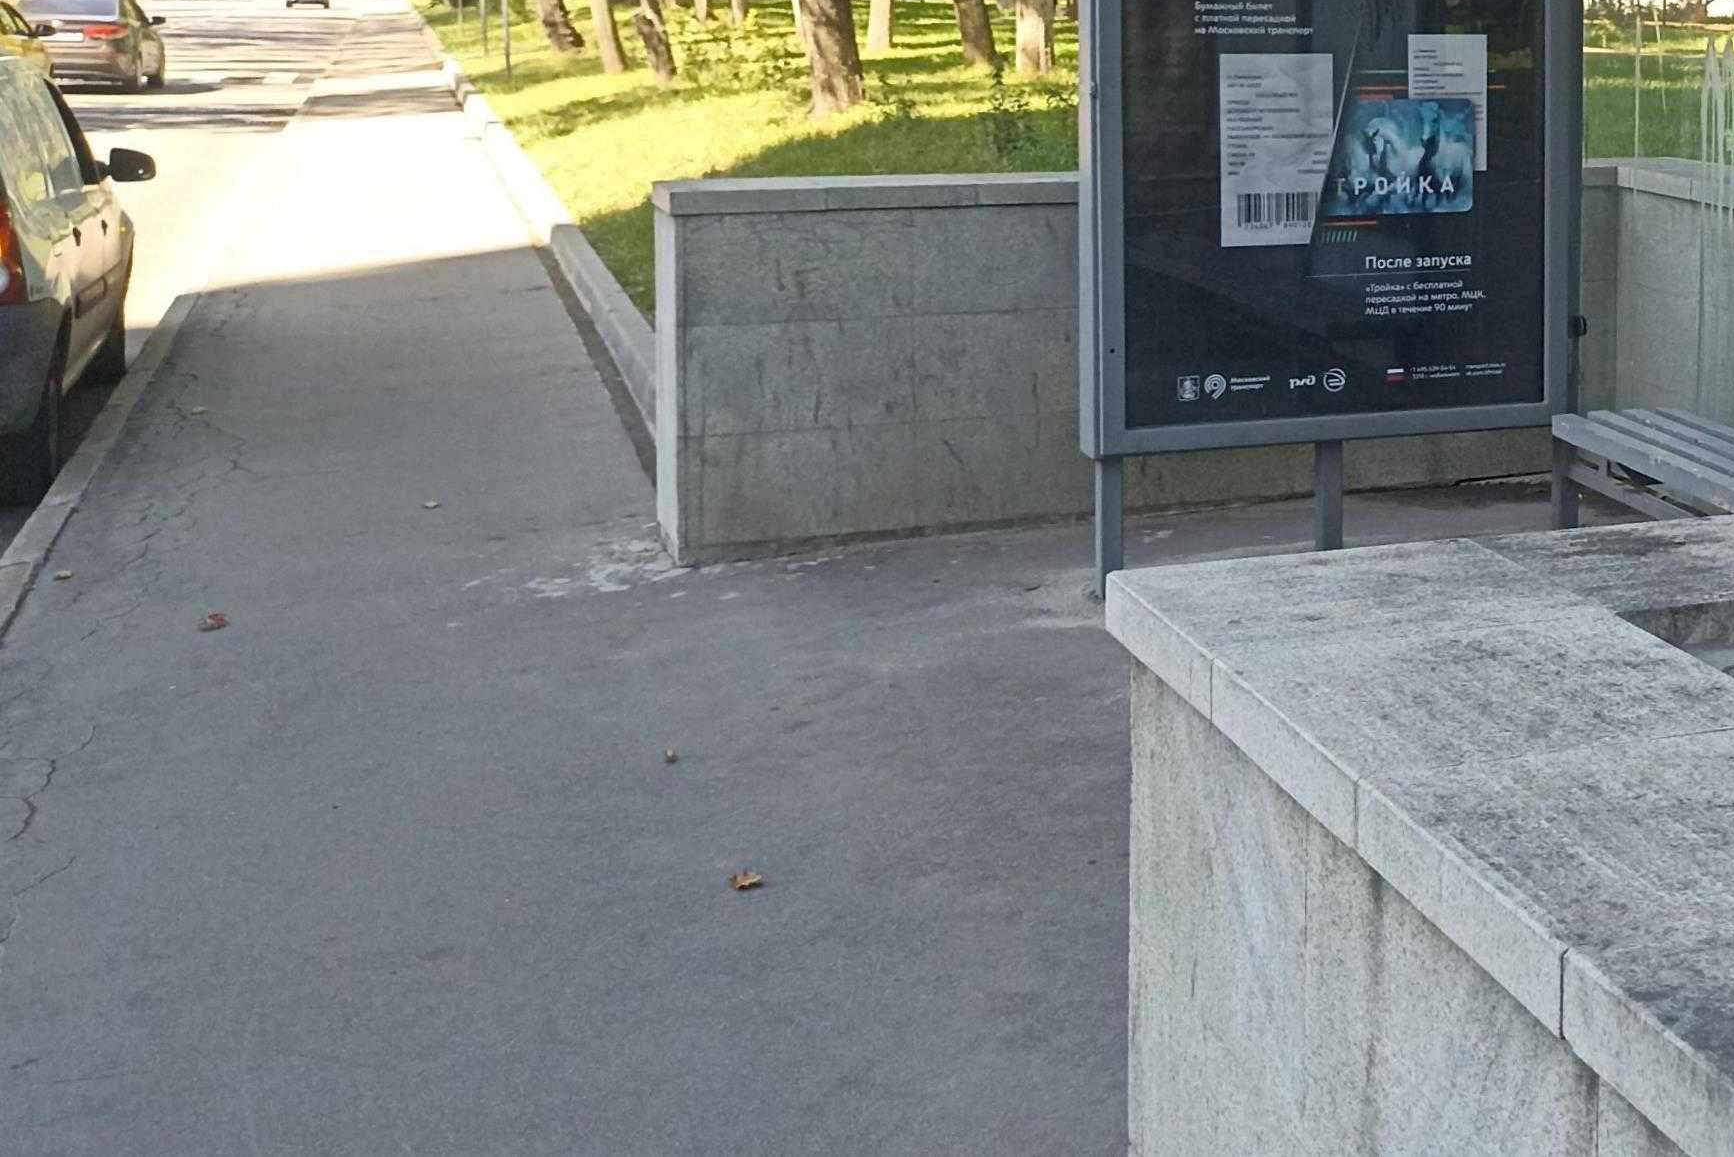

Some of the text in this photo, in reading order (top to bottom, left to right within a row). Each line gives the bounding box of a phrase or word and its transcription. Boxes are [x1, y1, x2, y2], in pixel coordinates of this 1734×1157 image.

[1365, 255, 1472, 269] После запуска
[1413, 280, 1463, 290] бесплатной
